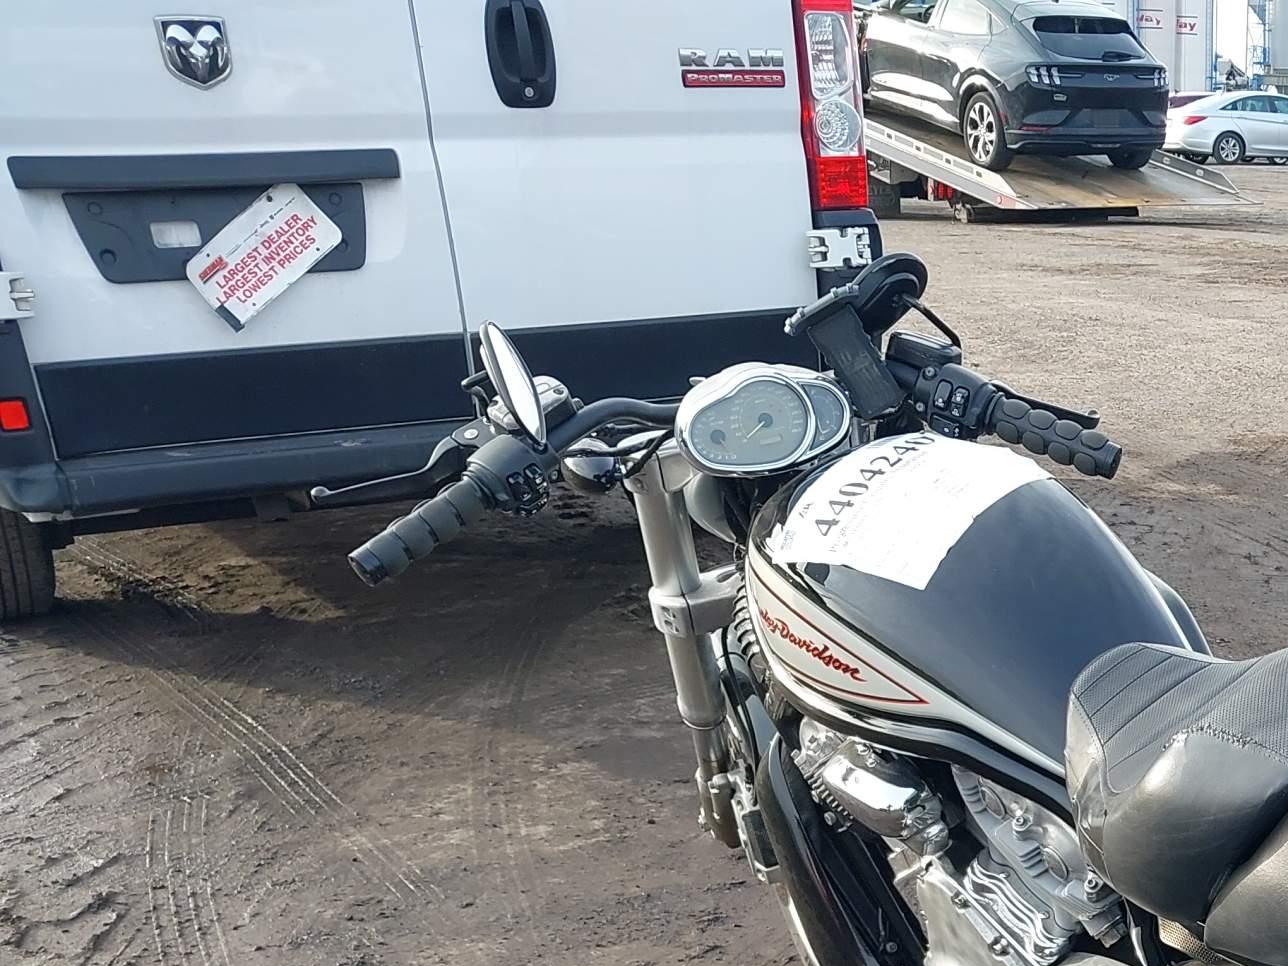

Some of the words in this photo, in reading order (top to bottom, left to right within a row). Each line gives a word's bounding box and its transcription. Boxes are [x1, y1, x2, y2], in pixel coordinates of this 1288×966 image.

[678, 48, 784, 67] RAM
[215, 246, 263, 290] LARGEST
[260, 213, 303, 251] DEALER
[215, 261, 266, 306] LARGEST
[262, 215, 319, 267] INVENTORY
[236, 266, 280, 304] LOWEST
[278, 234, 317, 270] PRICES
